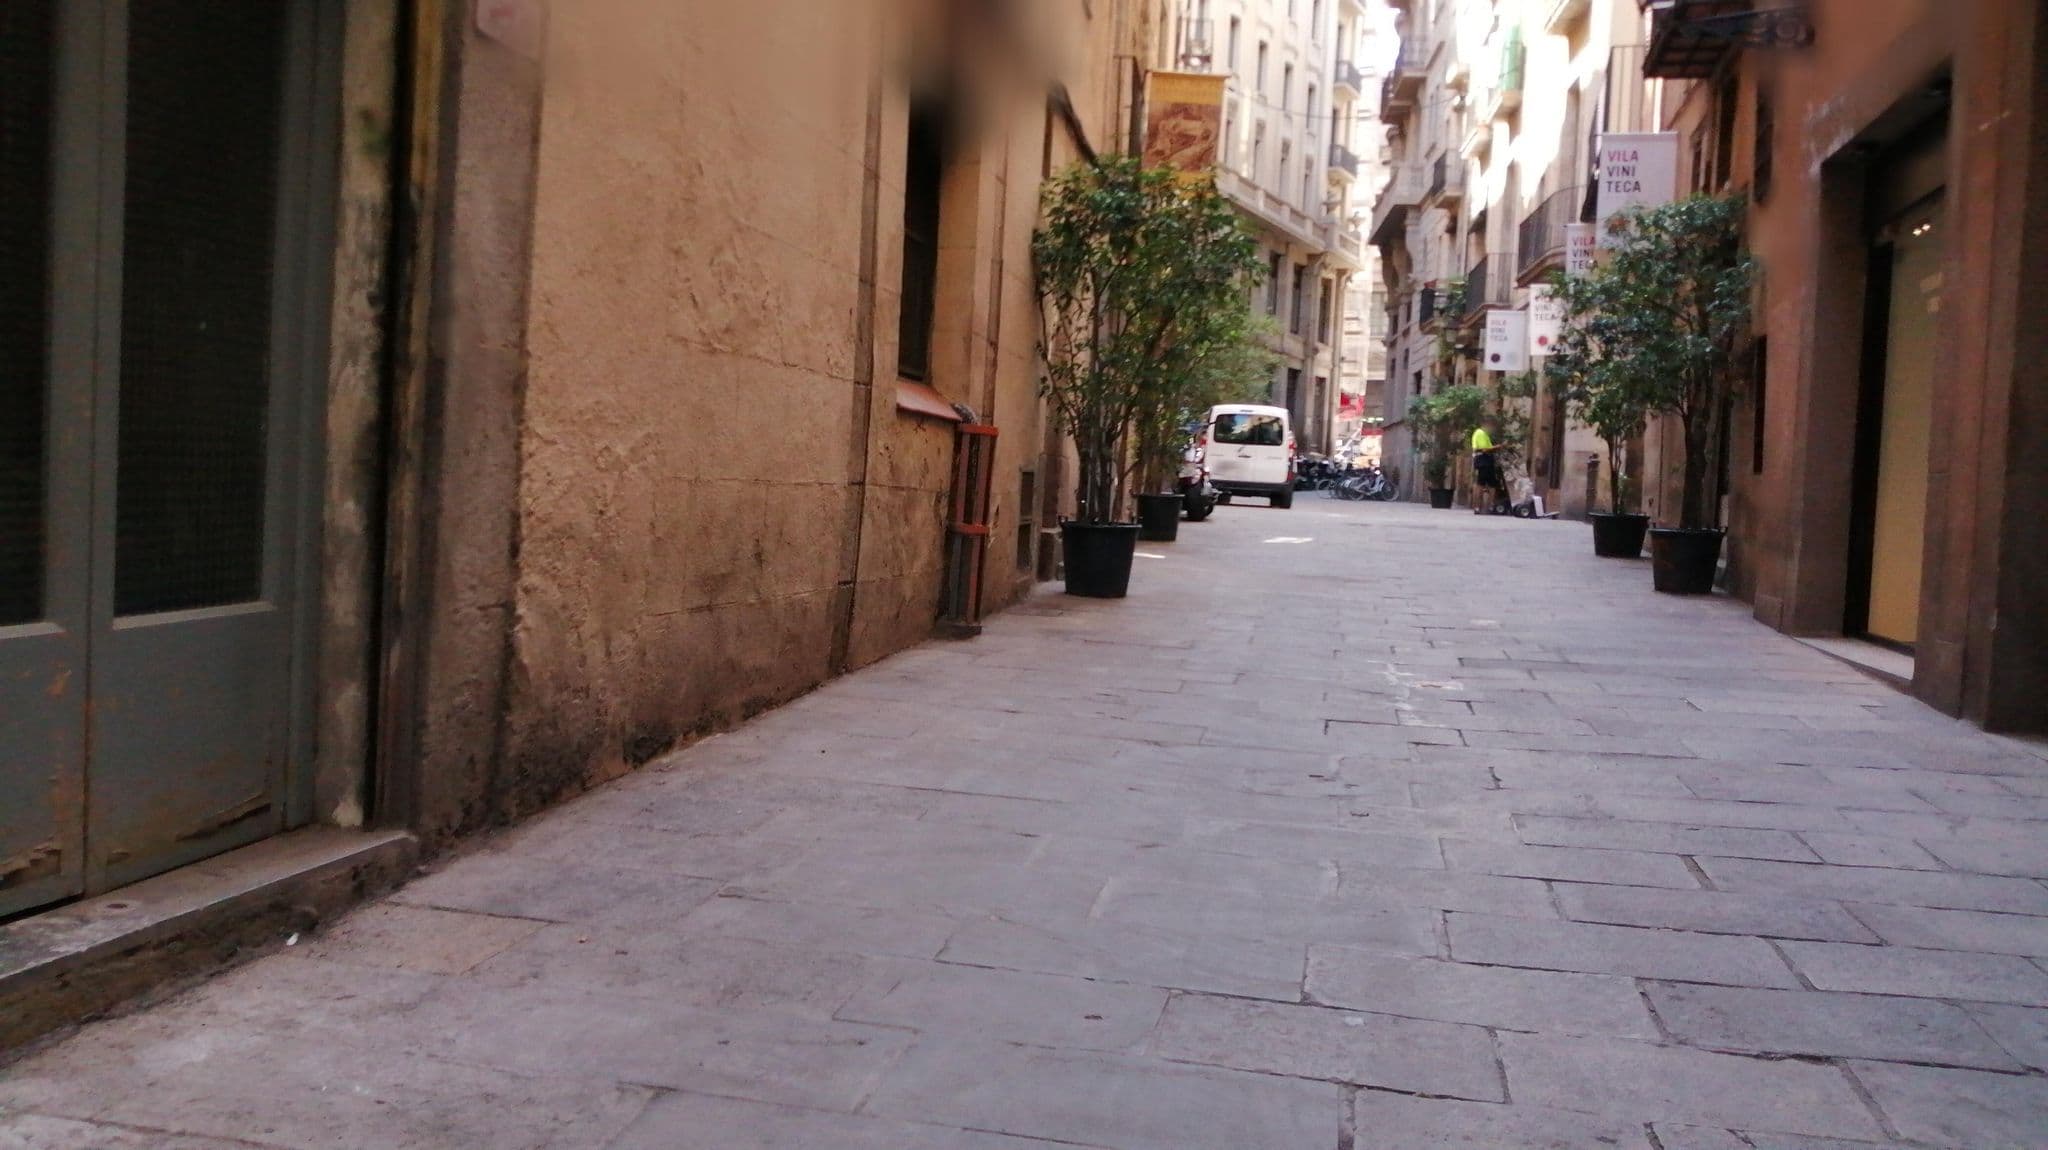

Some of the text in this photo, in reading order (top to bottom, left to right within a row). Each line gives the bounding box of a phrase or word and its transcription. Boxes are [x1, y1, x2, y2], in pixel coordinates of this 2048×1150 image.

[1607, 150, 1639, 162] VILA
[1606, 166, 1636, 177] VINI
[1606, 181, 1642, 193] TECA
[1572, 236, 1595, 246] VILA
